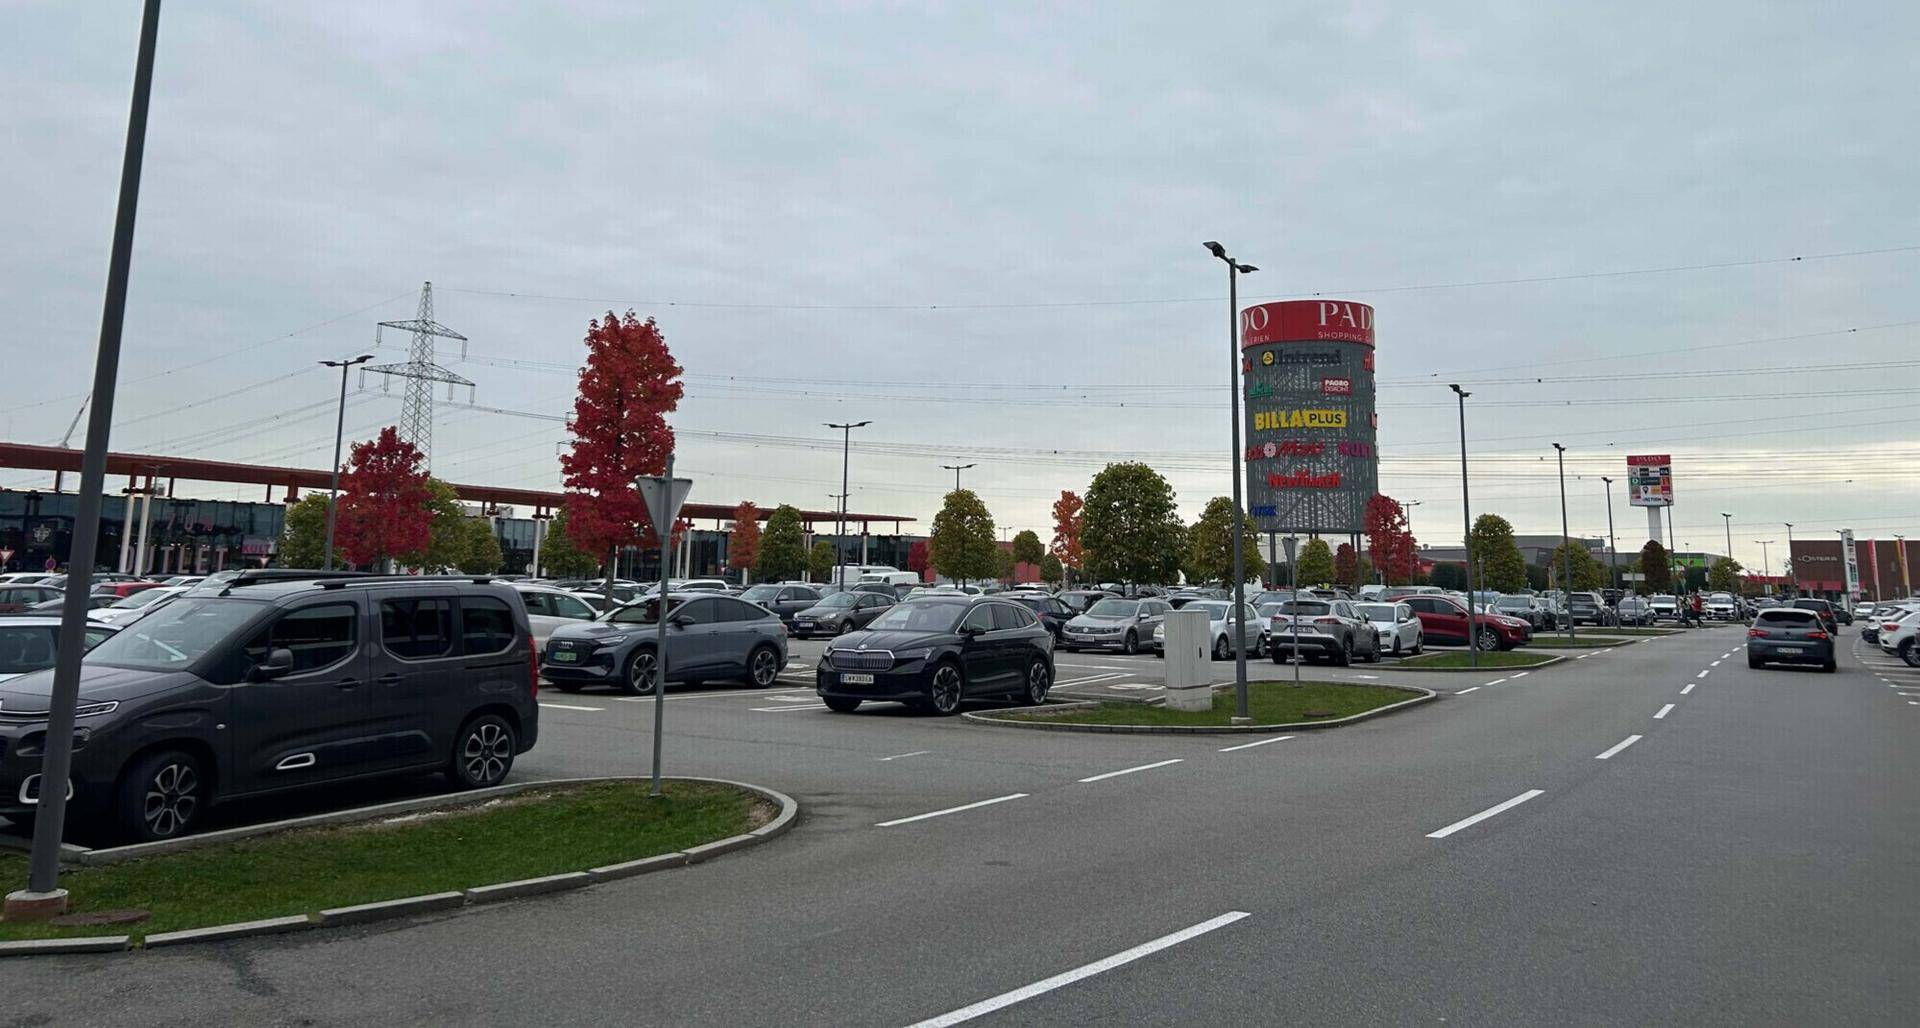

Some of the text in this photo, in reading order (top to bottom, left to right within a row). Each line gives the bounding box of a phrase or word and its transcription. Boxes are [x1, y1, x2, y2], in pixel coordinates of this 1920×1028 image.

[1318, 302, 1374, 330] PAD
[1254, 409, 1342, 430] BILLA PLUS
